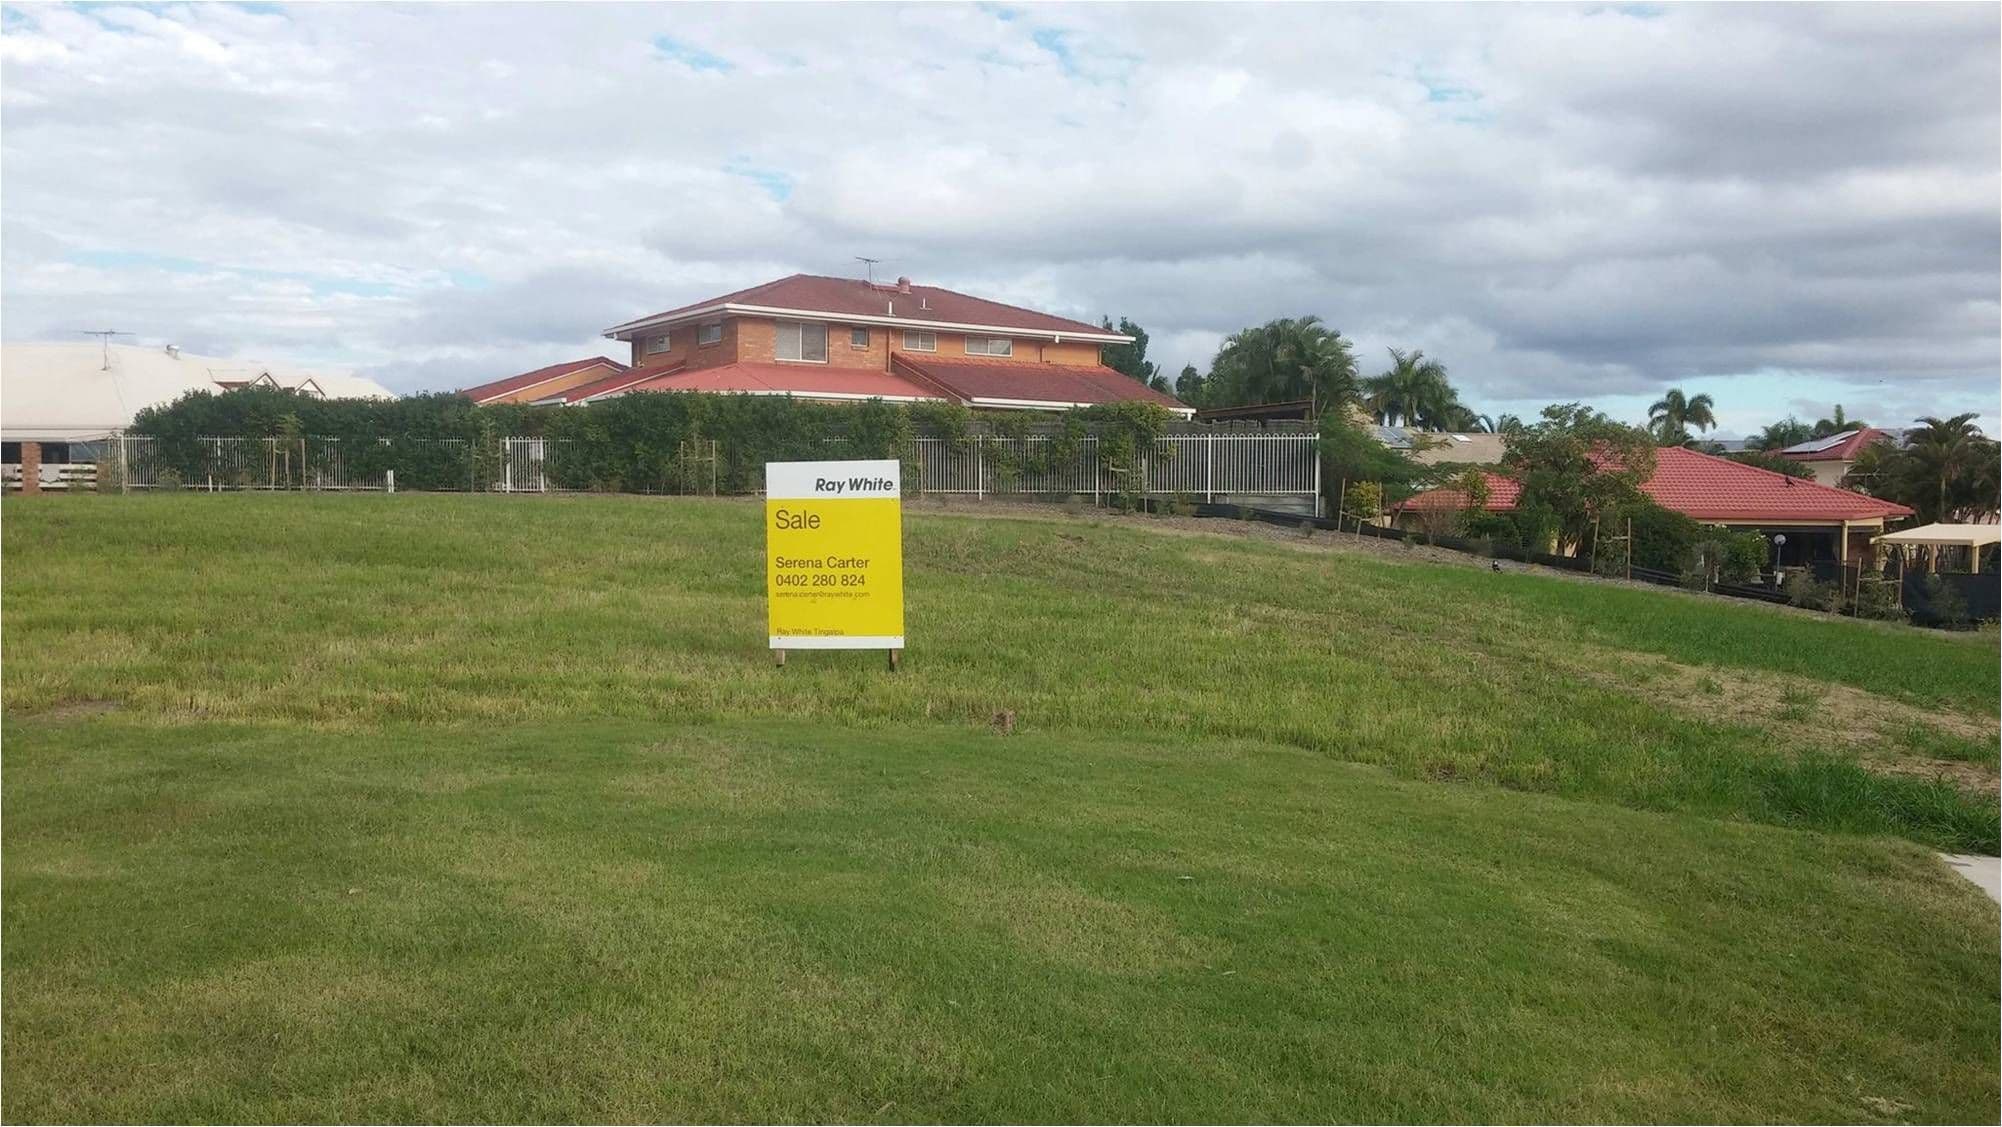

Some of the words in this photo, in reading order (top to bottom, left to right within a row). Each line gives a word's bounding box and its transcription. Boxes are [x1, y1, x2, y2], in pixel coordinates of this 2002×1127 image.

[815, 478, 845, 494] Ray
[848, 478, 894, 491] White
[775, 509, 821, 530] Sale
[775, 556, 822, 569] Serena
[826, 556, 870, 569] Carter
[775, 574, 808, 587] 0402
[812, 574, 837, 587] 280
[840, 574, 866, 587] 824
[776, 627, 790, 636] Ray
[791, 627, 811, 636] White
